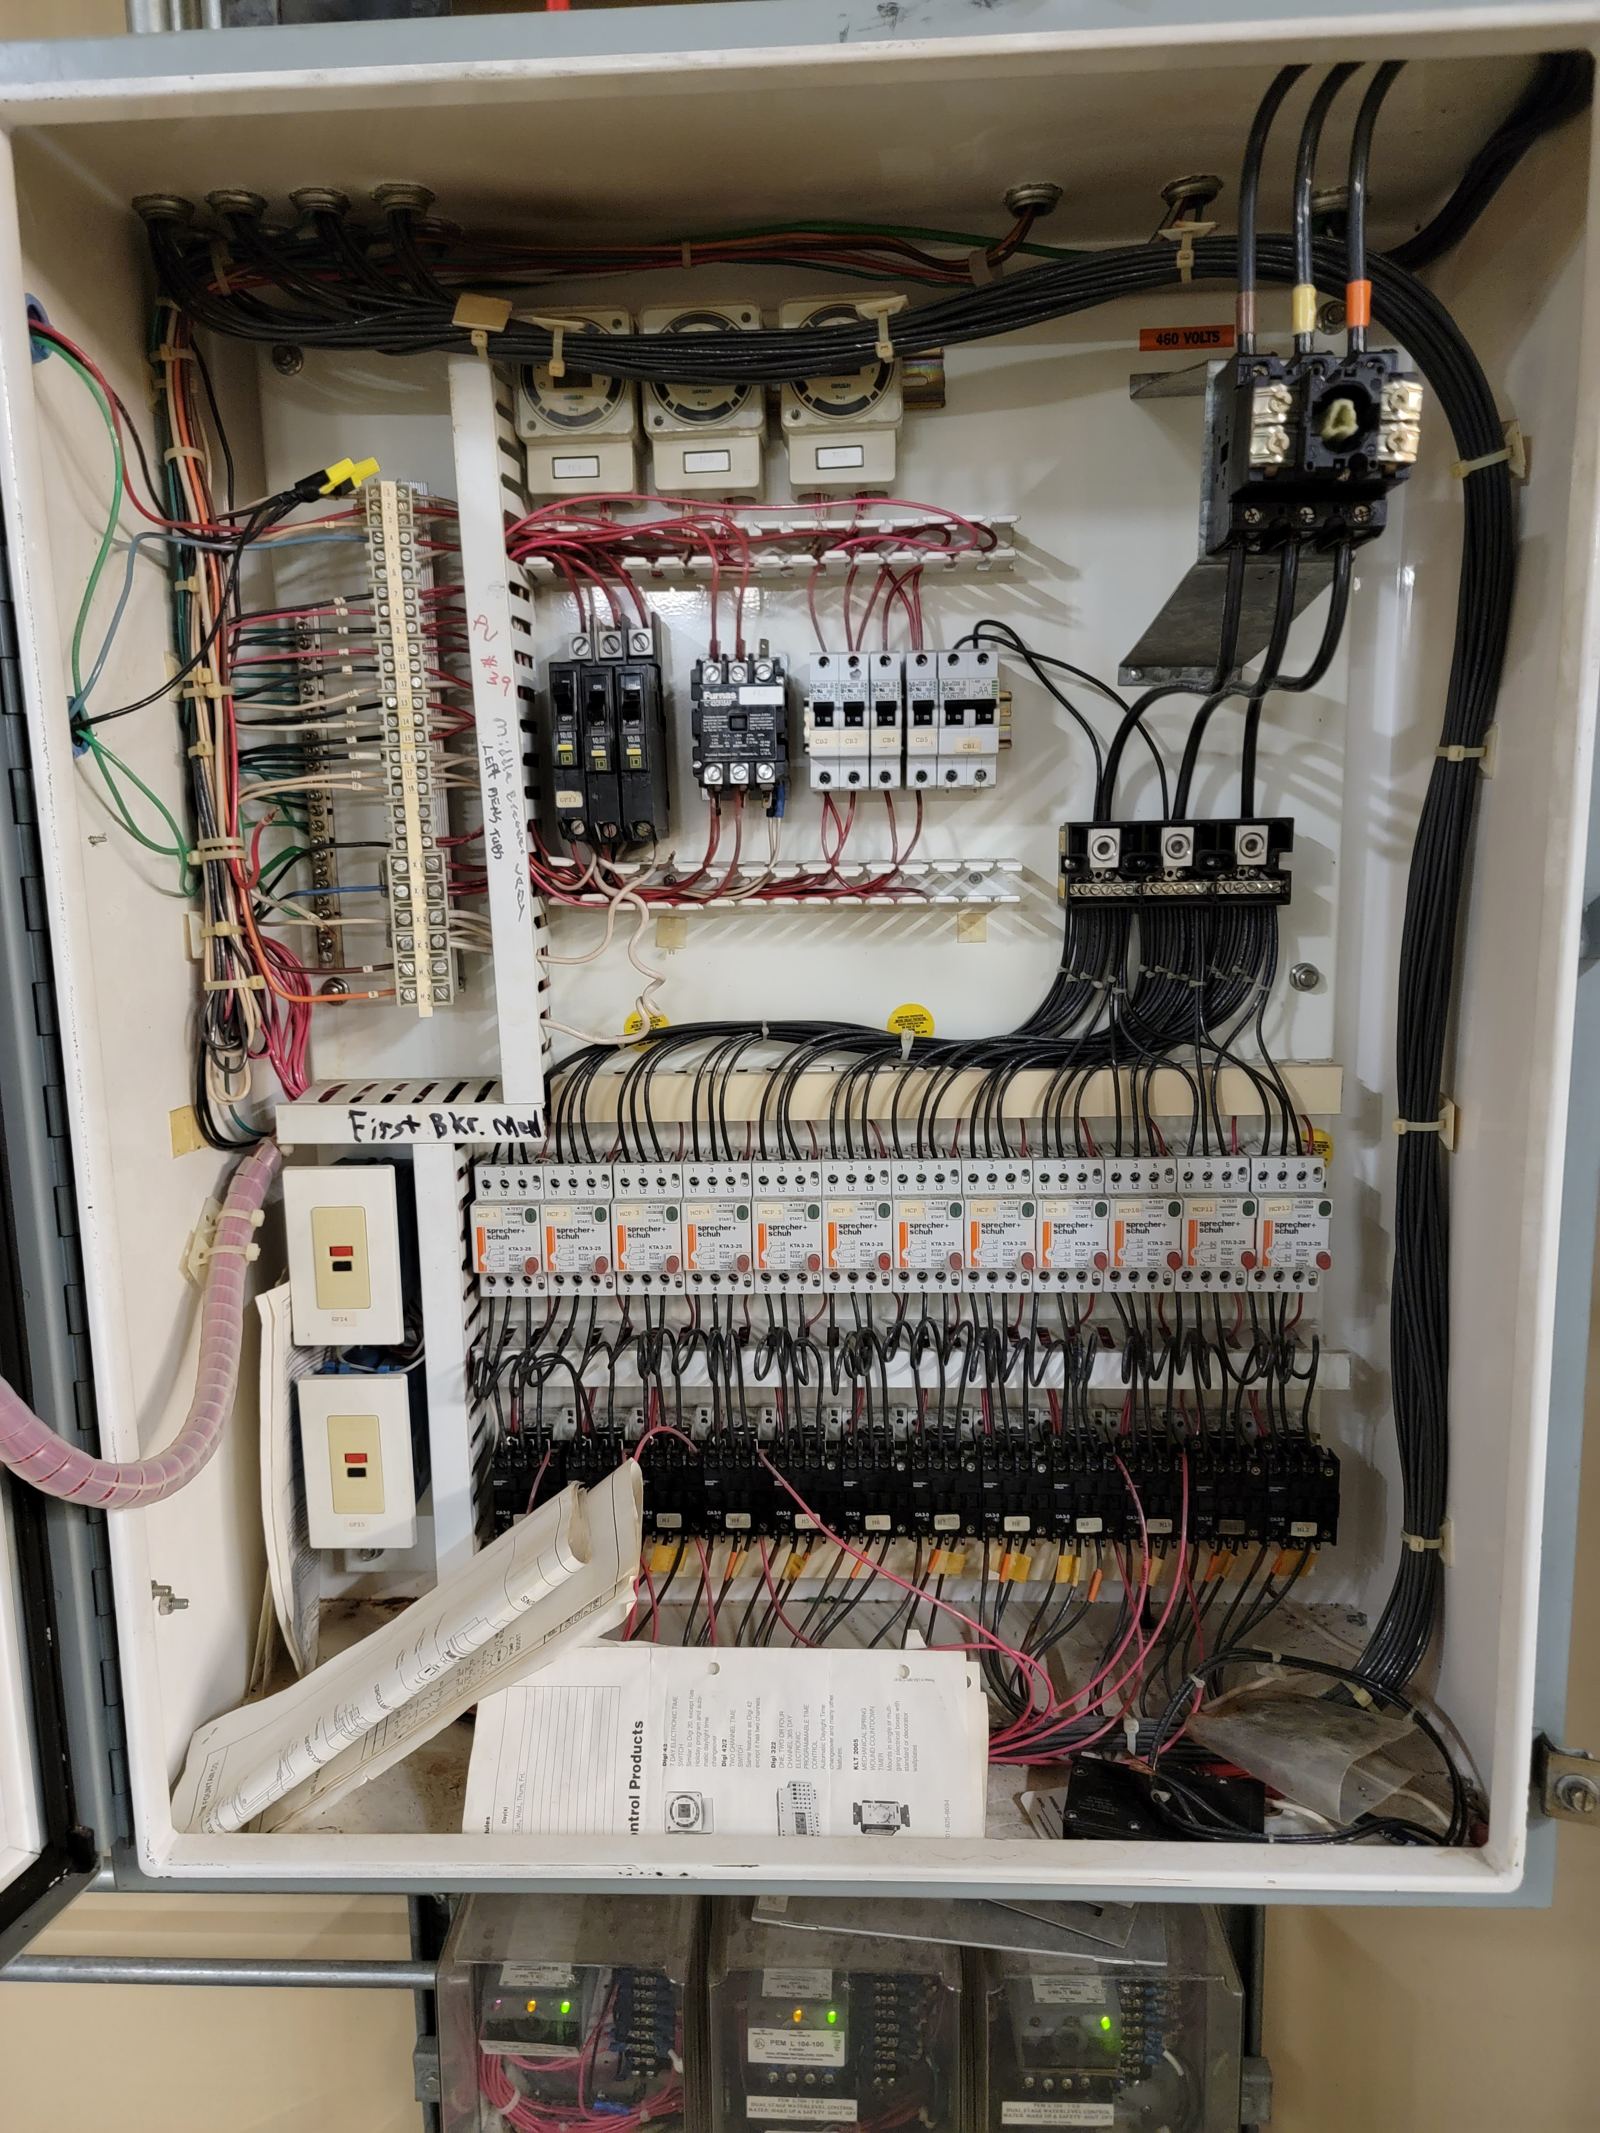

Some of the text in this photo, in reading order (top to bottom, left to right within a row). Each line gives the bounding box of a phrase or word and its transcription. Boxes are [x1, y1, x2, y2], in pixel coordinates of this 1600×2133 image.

[1156, 330, 1220, 345] 460 VOLTS
[703, 691, 737, 700] Furnas
[349, 1110, 420, 1142] First
[627, 1226, 666, 1234] sprecher+
[698, 1225, 736, 1233] sprecher+
[1054, 1222, 1092, 1230] sprecher+
[1275, 1222, 1316, 1230] sprecher+
[629, 1720, 645, 1790] Products
